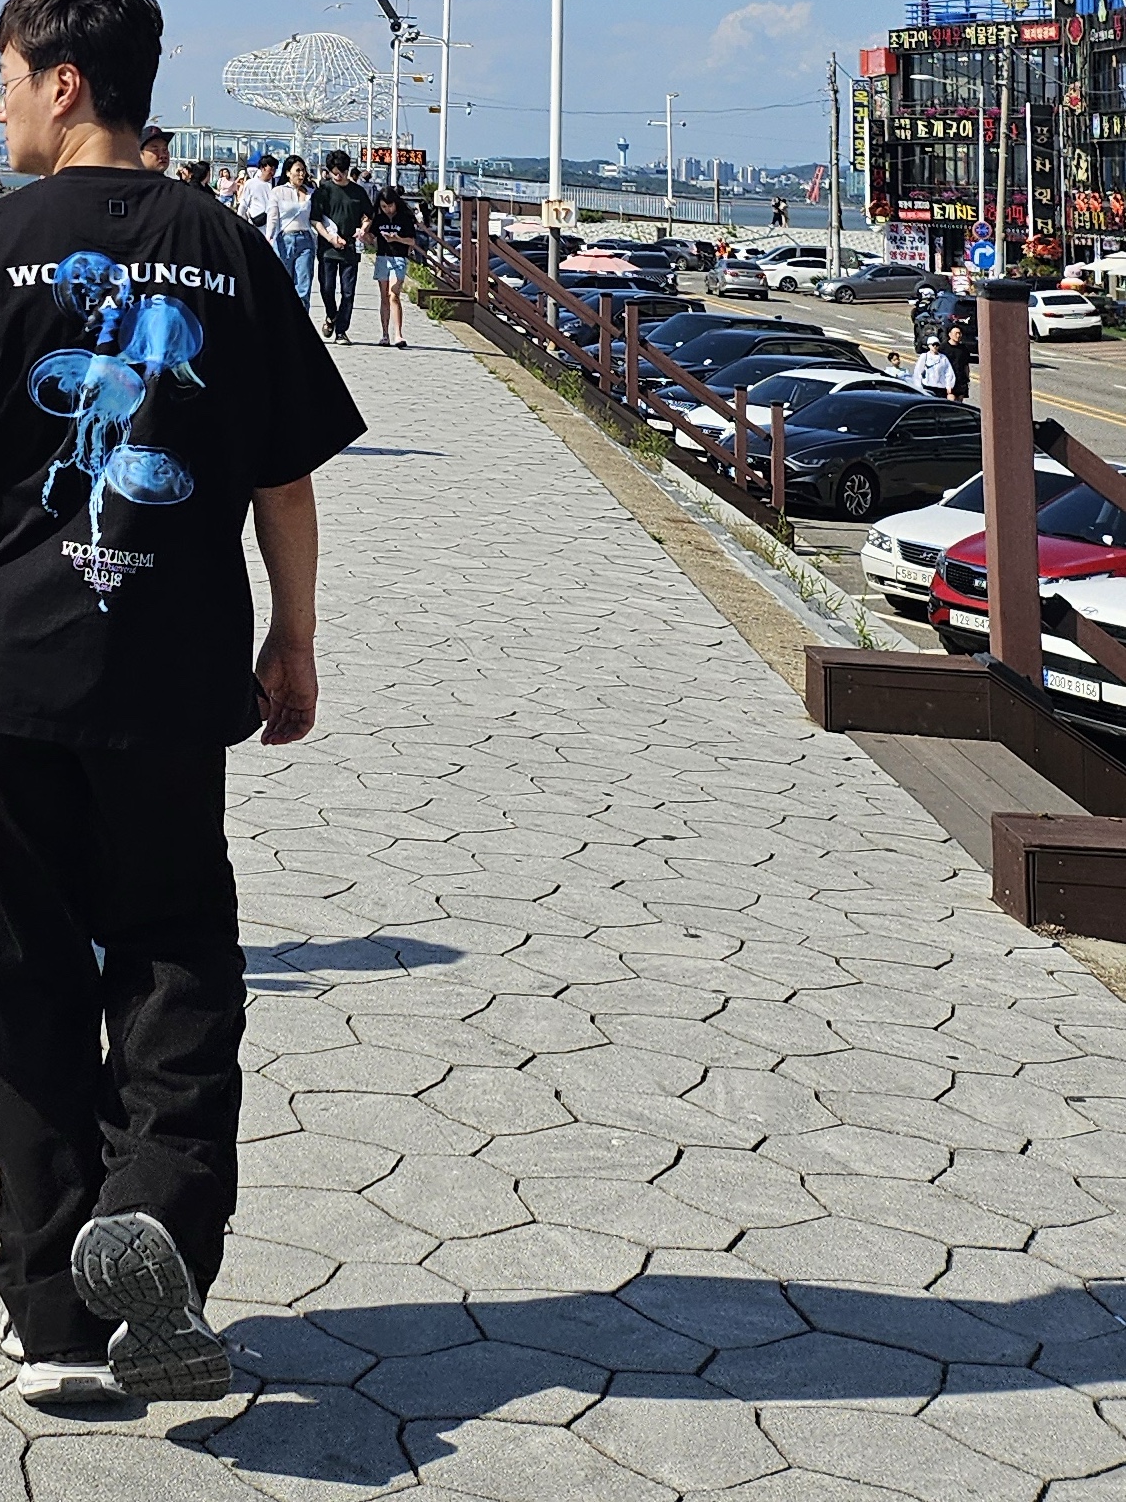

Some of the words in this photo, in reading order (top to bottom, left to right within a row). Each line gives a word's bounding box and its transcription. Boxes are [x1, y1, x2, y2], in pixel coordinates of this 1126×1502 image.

[889, 29, 929, 49] 조개구이
[917, 119, 973, 139] 조개구이
[1102, 115, 1126, 138] 풍차
[553, 207, 572, 221] 17
[85, 293, 167, 311] PARIS
[84, 567, 123, 588] PARIS
